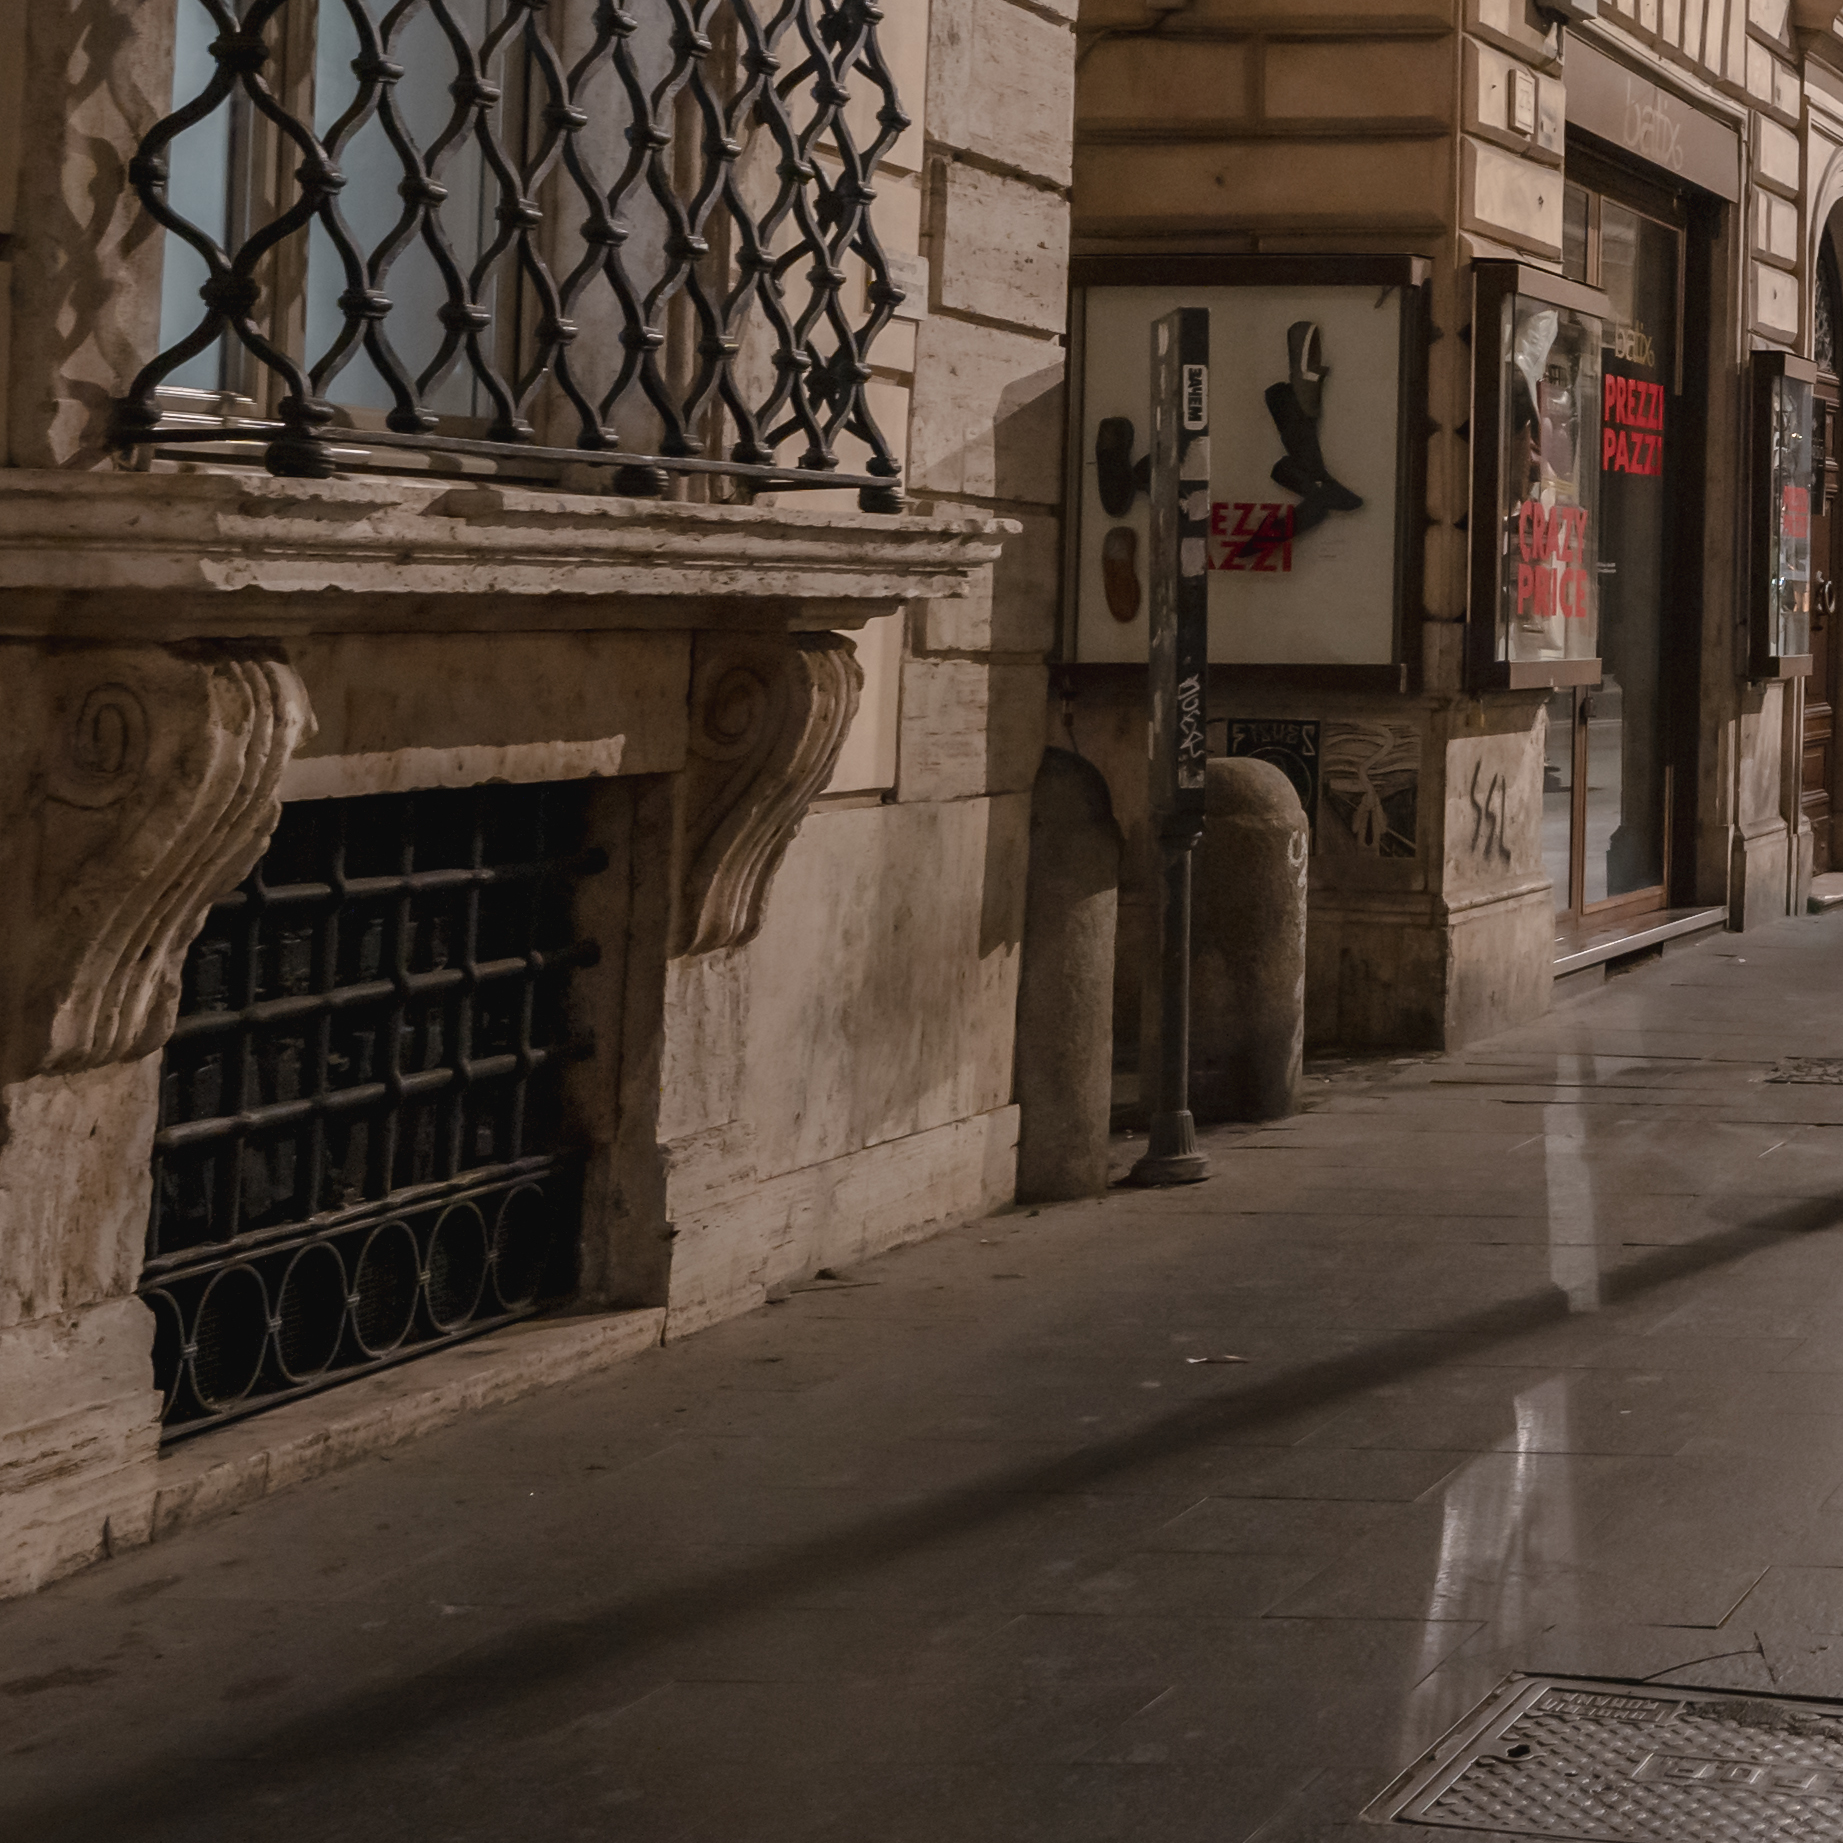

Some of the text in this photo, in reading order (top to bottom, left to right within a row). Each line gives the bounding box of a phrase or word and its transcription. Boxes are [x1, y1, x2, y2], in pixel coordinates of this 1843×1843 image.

[1604, 373, 1664, 431] PREZZI
[1602, 427, 1662, 476] PAZZI
[1211, 502, 1295, 537] EZZI
[1518, 500, 1588, 563] CRAZY
[1517, 563, 1588, 618] PRICE
